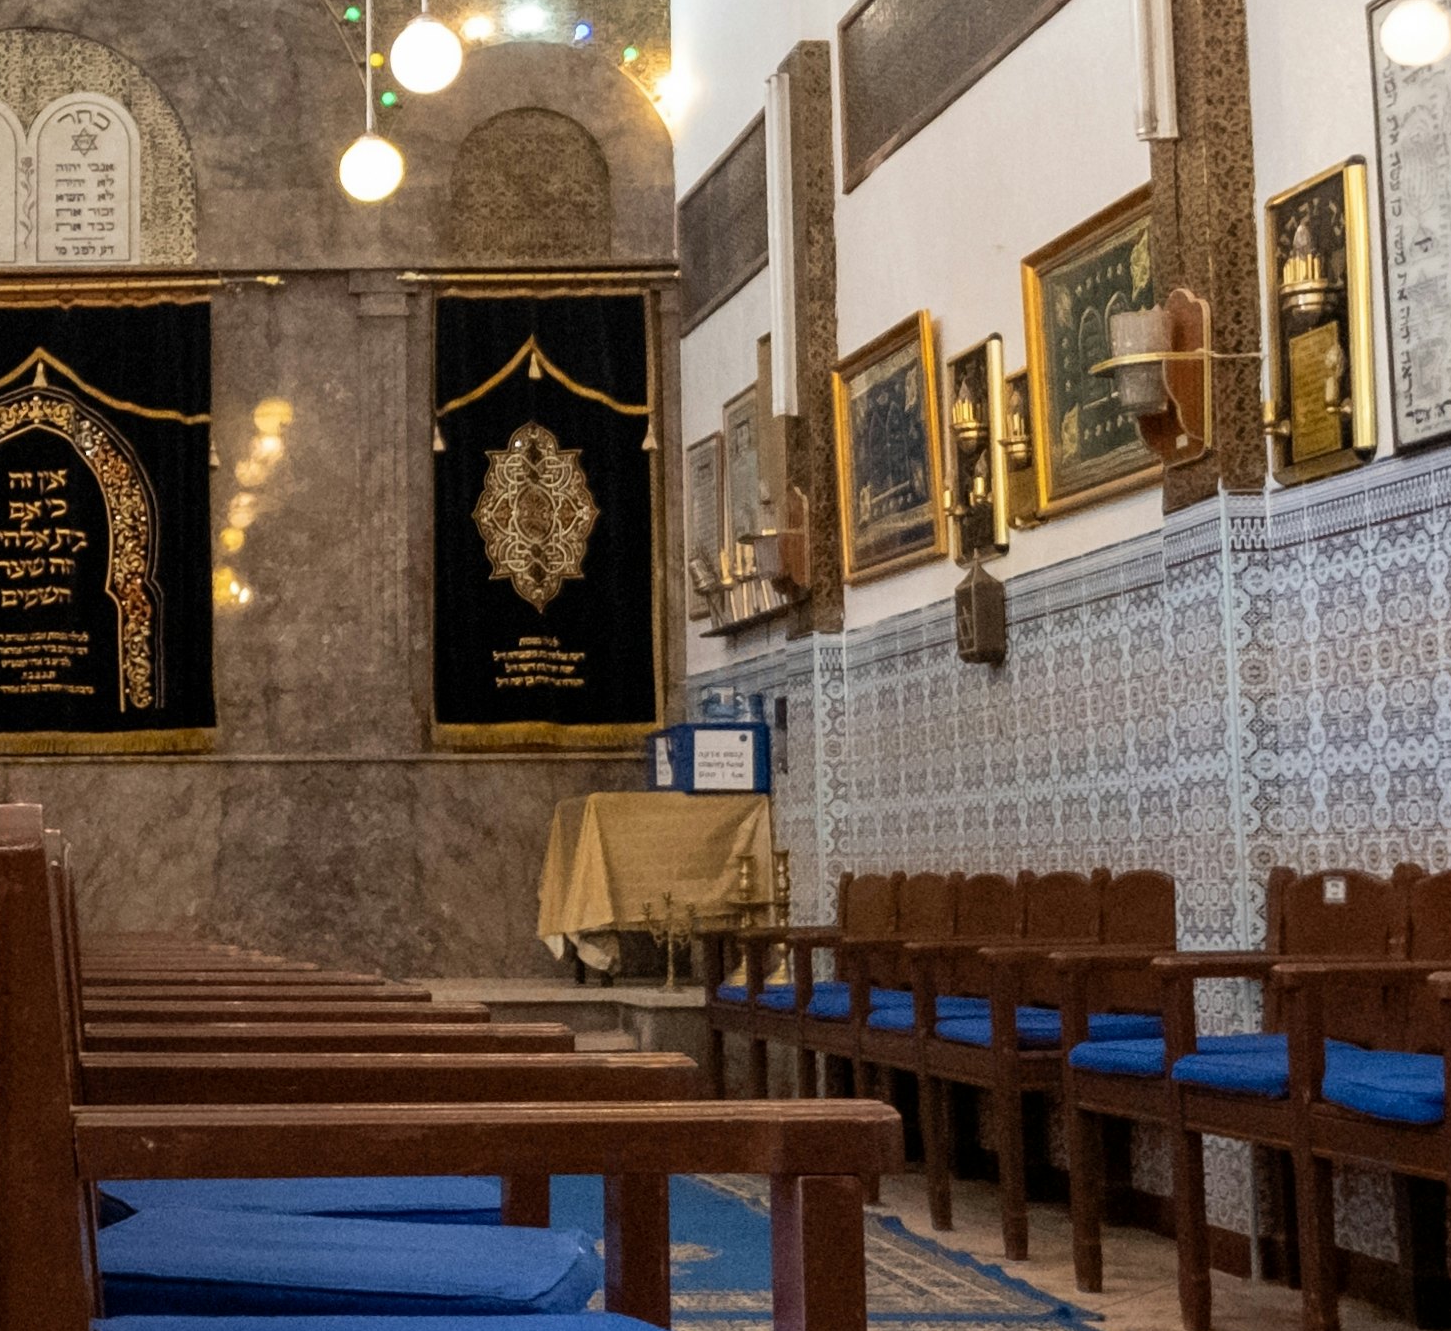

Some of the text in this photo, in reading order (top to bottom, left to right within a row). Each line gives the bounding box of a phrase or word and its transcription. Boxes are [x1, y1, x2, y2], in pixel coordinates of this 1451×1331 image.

[57, 109, 111, 131] כתר
[56, 163, 114, 172] אנכי יהוה
[97, 174, 114, 188] לא
[97, 190, 114, 202] לא
[88, 208, 114, 217] זכור
[87, 222, 114, 231] כבד
[55, 242, 114, 257] דע לפני מי
[8, 469, 67, 495] אין זה
[9, 499, 67, 521] כי אם
[49, 528, 87, 552] בית
[1, 586, 71, 609] השמים
